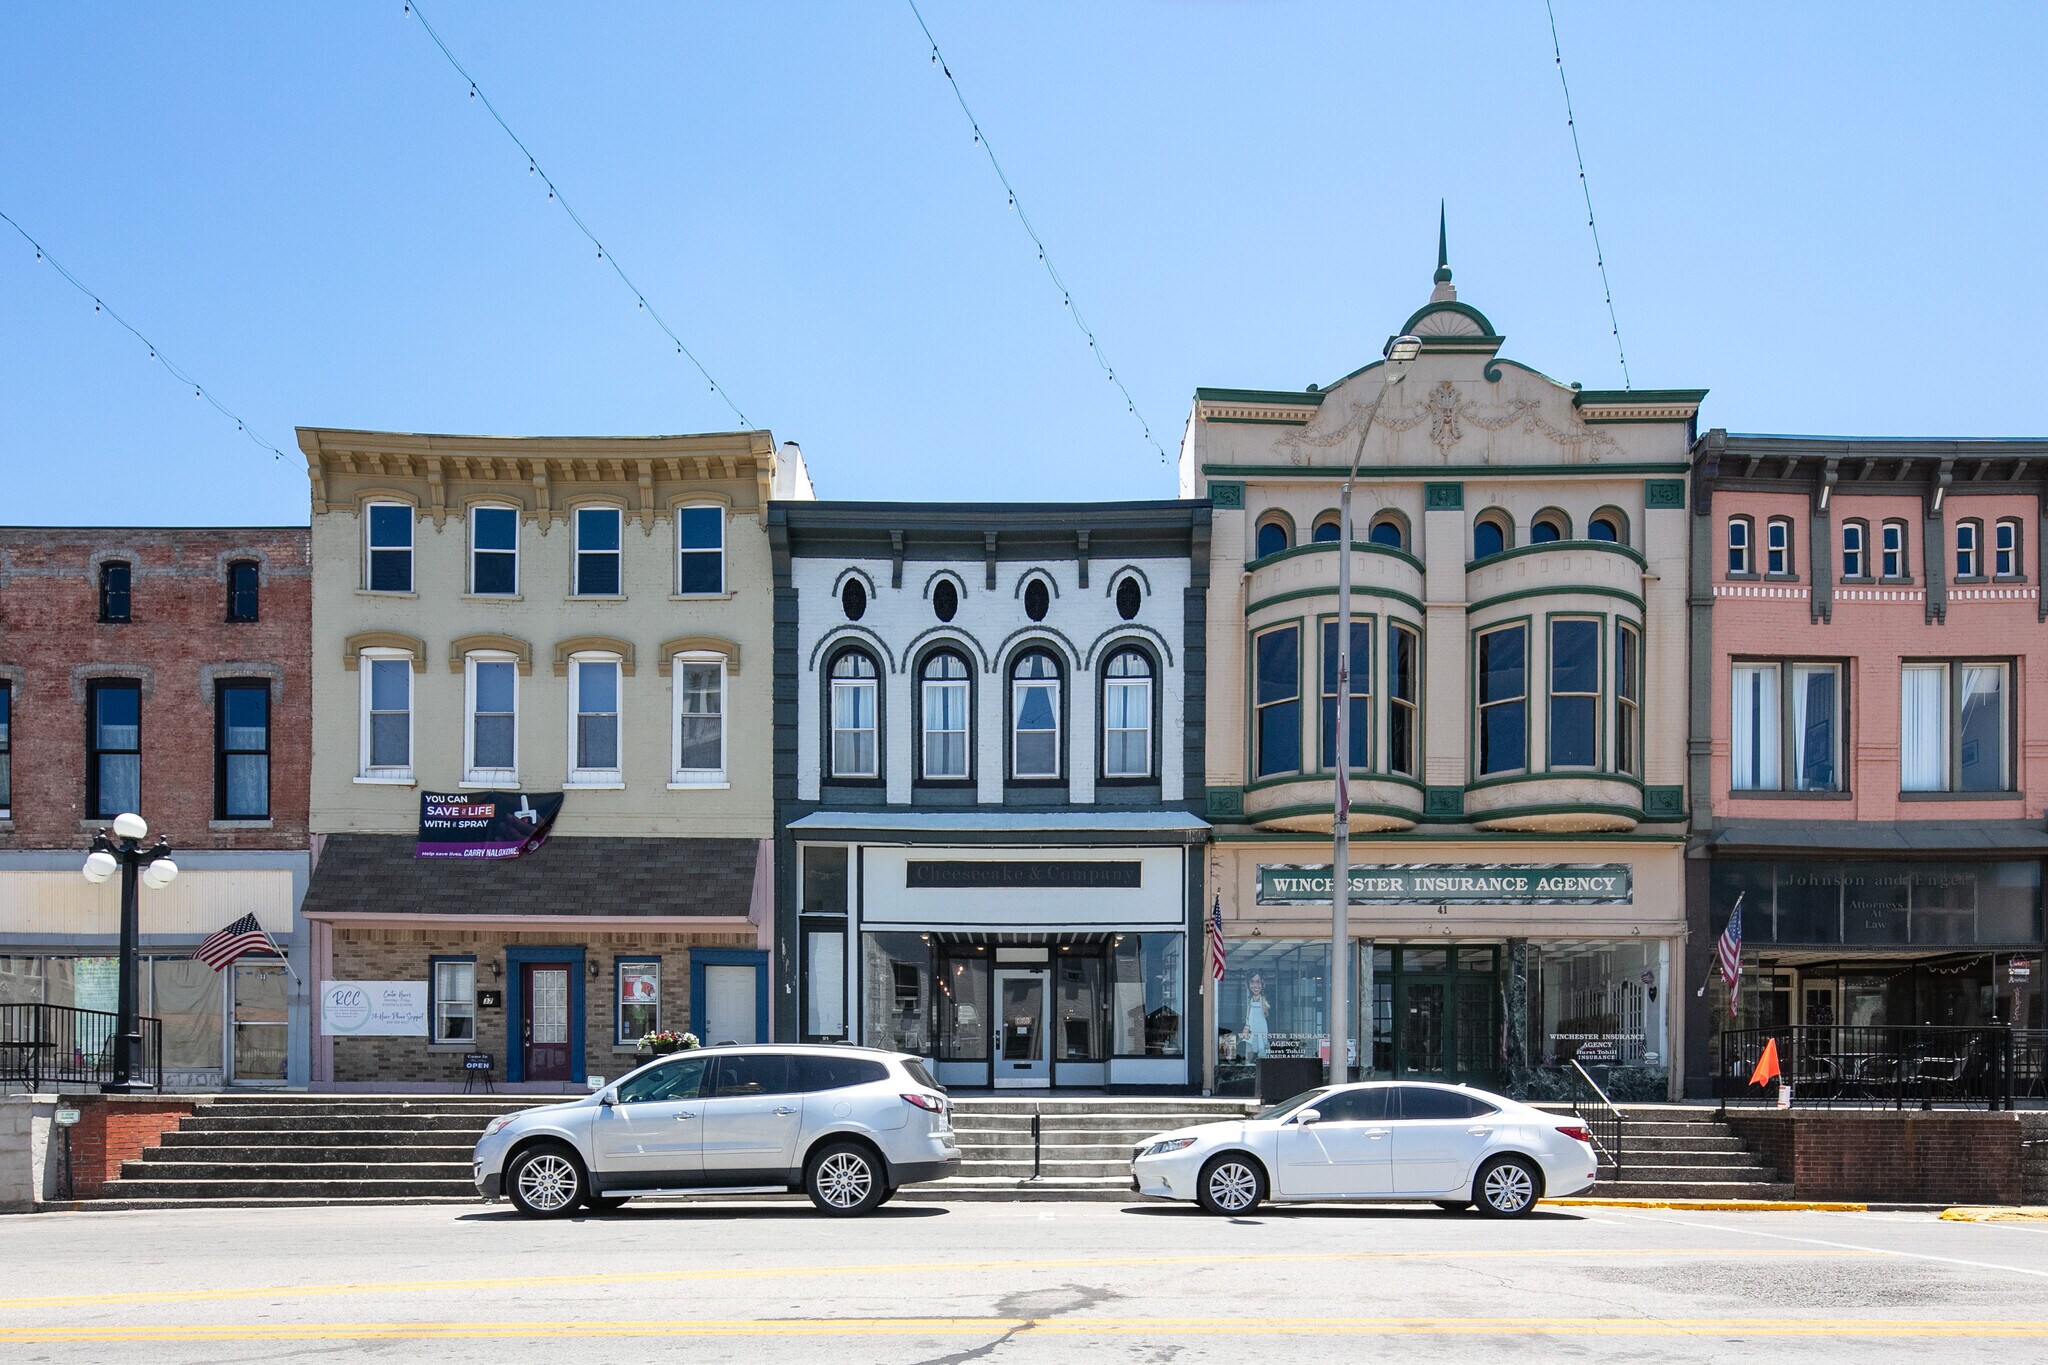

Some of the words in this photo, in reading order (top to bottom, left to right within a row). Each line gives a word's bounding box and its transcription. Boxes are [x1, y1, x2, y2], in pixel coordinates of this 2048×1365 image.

[425, 795, 445, 803] YOU
[447, 795, 468, 803] CAN
[427, 806, 459, 816] SAVE
[468, 806, 492, 816] LIFE
[424, 820, 451, 828] WITH
[458, 820, 489, 828] SPRAY
[463, 849, 485, 857] CARRY
[916, 866, 1023, 881] Cheesecake
[1047, 866, 1134, 884] Company
[1786, 874, 1865, 886] Johnson
[1273, 878, 1403, 892] WINCHSTER
[1414, 877, 1528, 892] INSURANCE
[1536, 877, 1617, 891] AGENCY
[1437, 905, 1447, 914] 41
[1850, 900, 1904, 910] Attorneys
[1870, 908, 1882, 918] At
[1865, 920, 1887, 929] Law
[332, 990, 361, 1006] RCC
